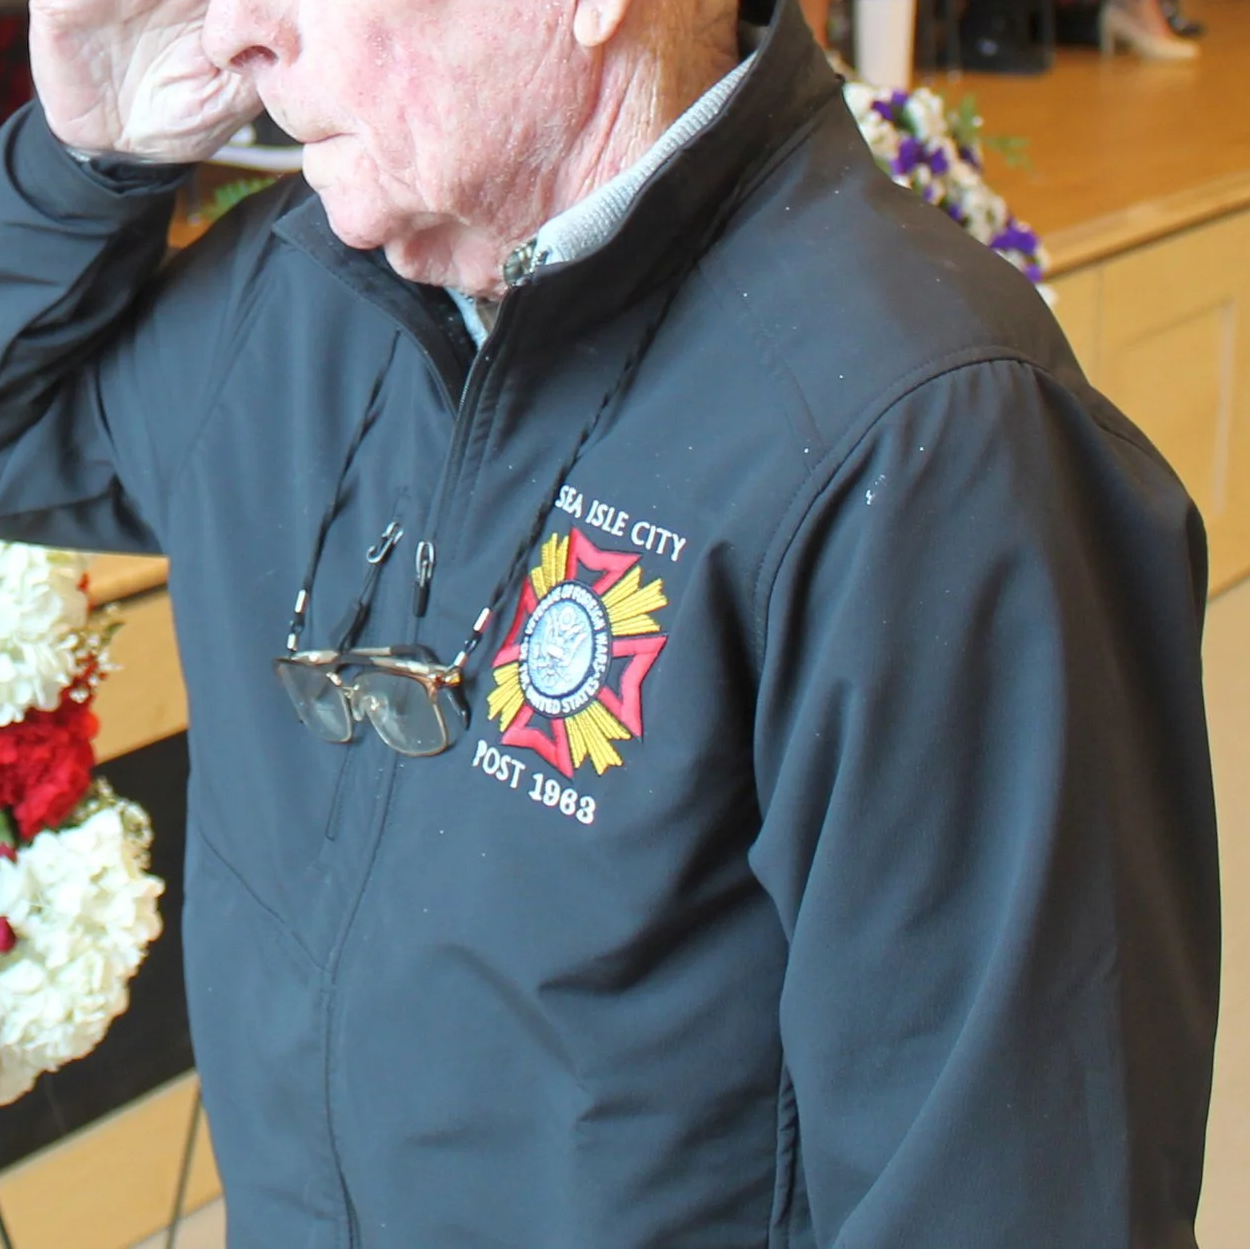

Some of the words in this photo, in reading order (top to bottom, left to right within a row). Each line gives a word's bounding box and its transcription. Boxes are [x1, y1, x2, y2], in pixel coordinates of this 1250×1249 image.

[555, 485, 583, 519] SEA
[586, 499, 629, 537] ISLE
[631, 521, 687, 562] CITY
[572, 586, 606, 630] FOREIGN
[593, 632, 608, 672] WARS
[562, 676, 599, 713] STATES
[472, 739, 525, 789] POST
[528, 773, 597, 824] 1963
